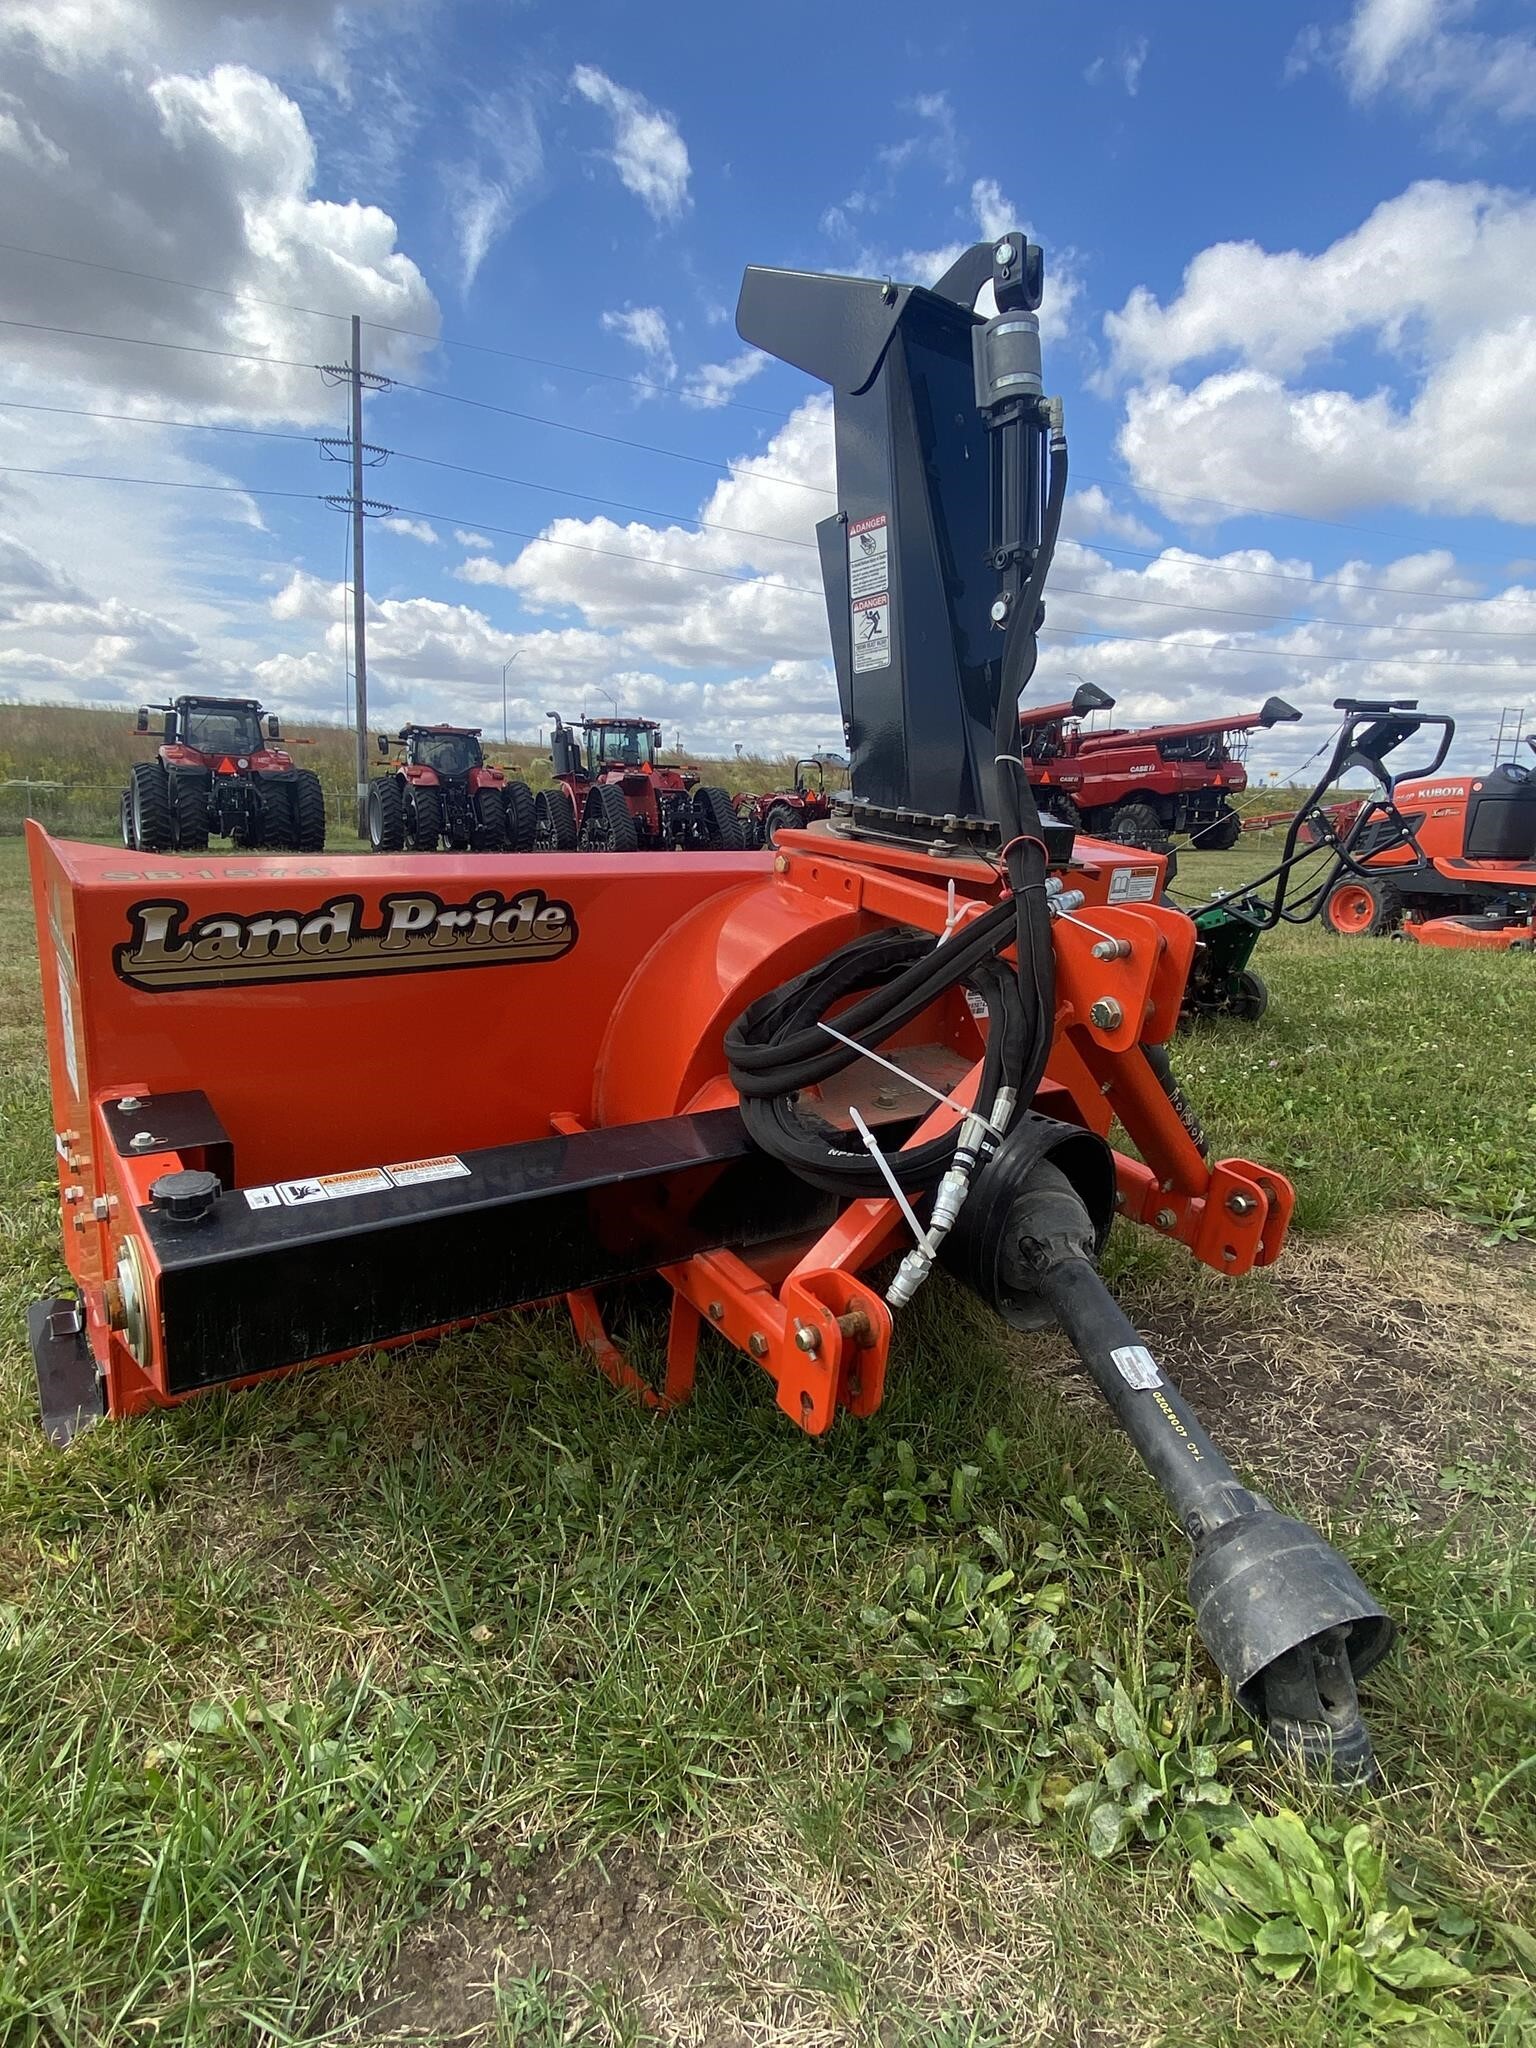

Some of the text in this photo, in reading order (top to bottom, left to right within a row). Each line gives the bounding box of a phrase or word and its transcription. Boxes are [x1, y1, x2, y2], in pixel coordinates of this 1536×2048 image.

[856, 515, 886, 533] DANGER
[859, 596, 887, 610] DANGER
[1130, 765, 1148, 773] CASE
[1418, 787, 1465, 798] KUBOTA
[102, 868, 332, 882] SB1574
[130, 895, 568, 964] Land Pride
[403, 1157, 456, 1171] WARNING
[332, 1171, 379, 1184] WARNING
